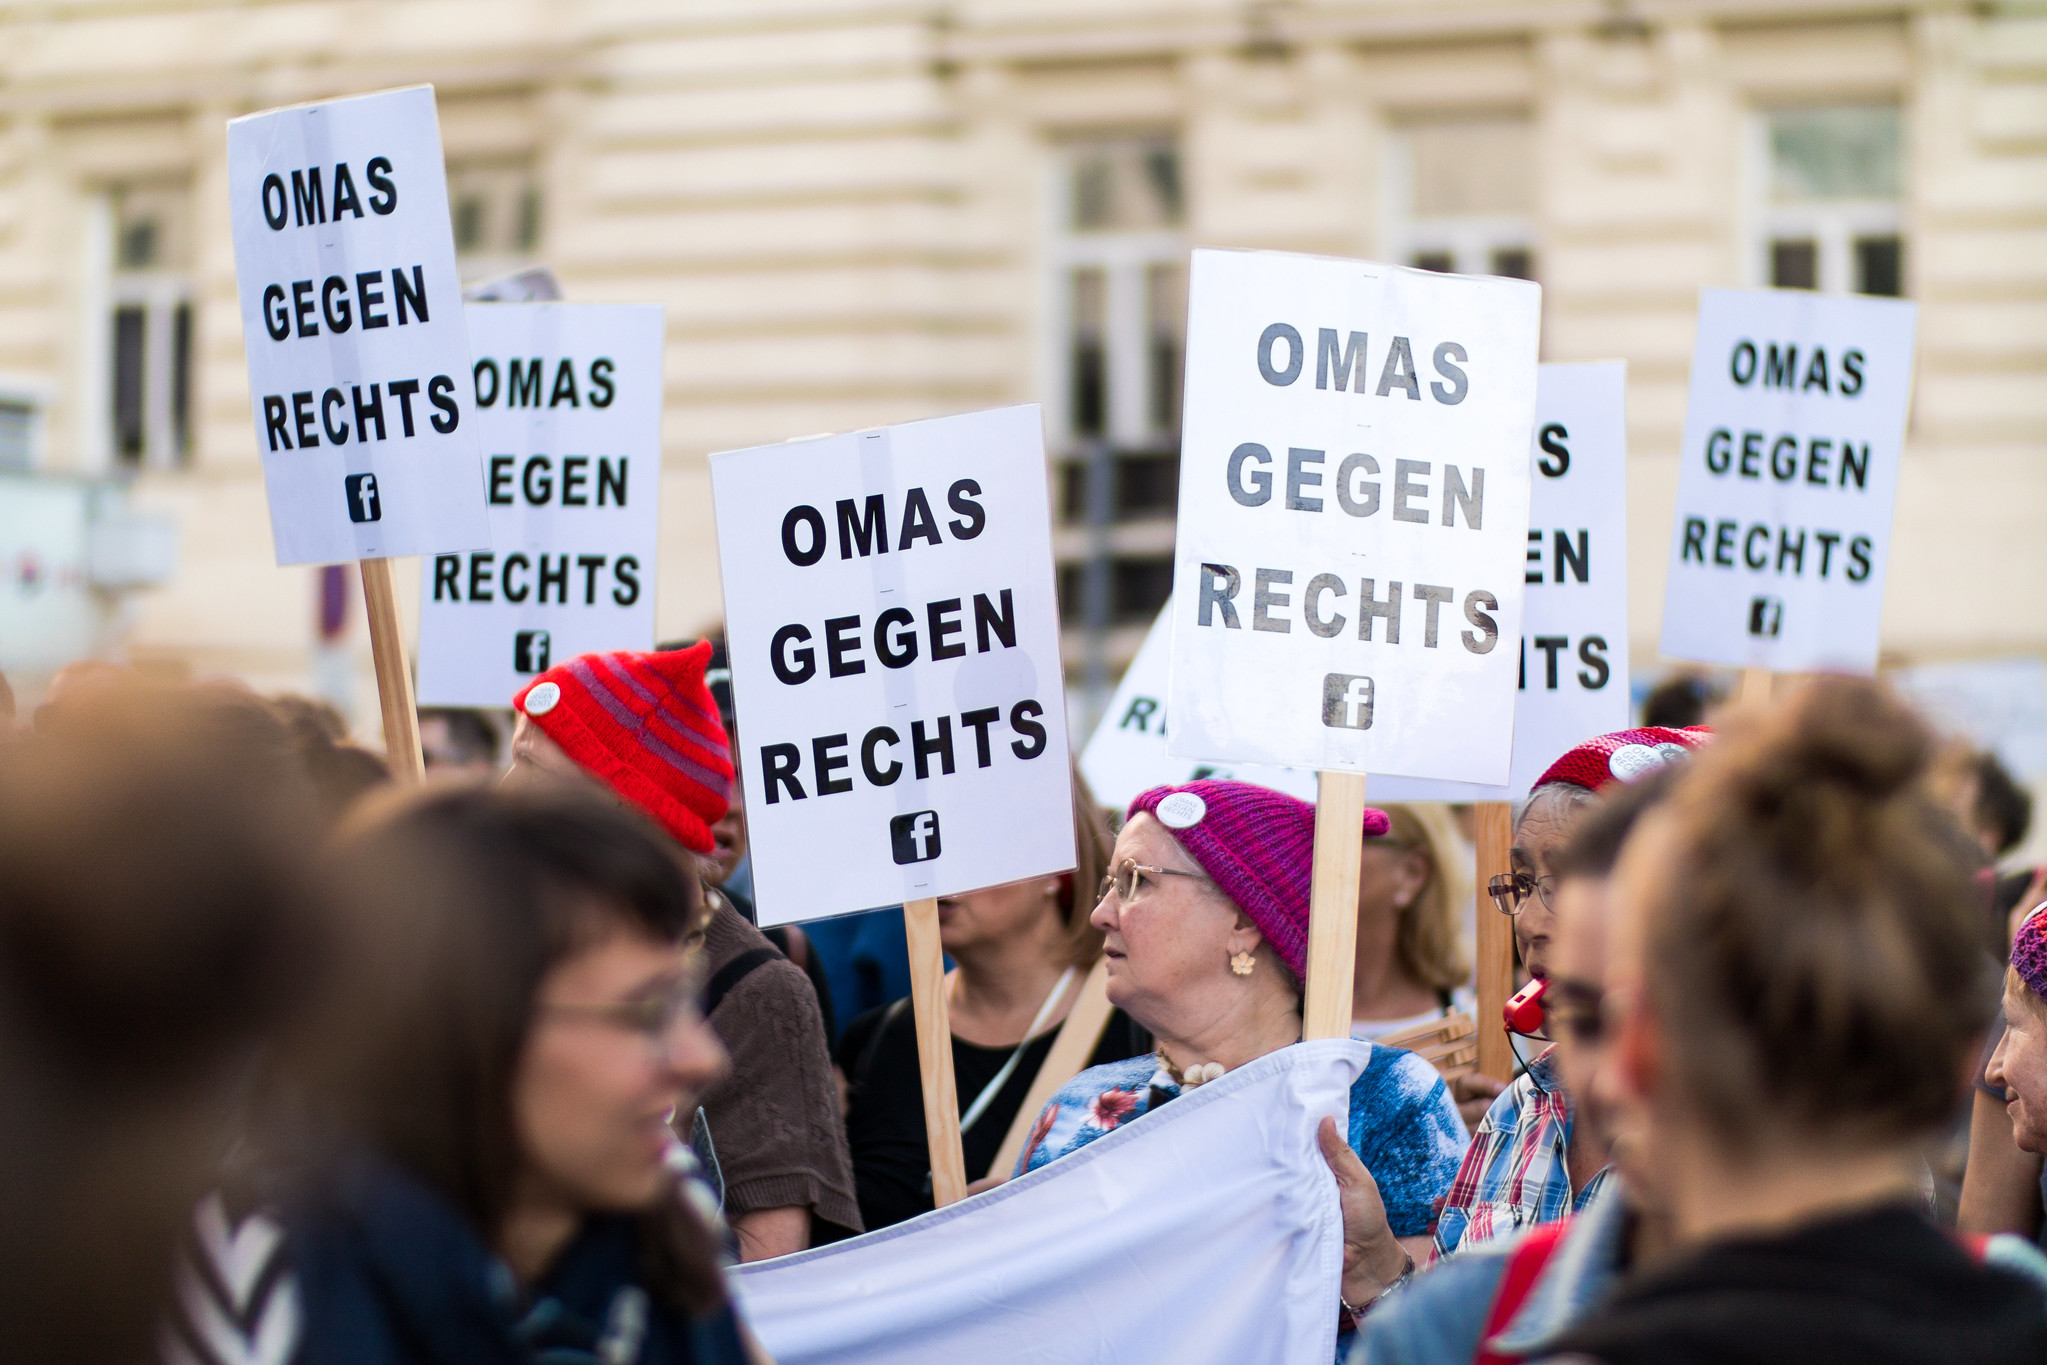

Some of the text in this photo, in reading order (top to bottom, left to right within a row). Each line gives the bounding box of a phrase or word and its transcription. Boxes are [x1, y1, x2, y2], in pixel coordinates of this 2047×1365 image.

[261, 156, 398, 232] OMAS
[262, 264, 430, 342] GEGEN
[473, 357, 616, 409] OMAS
[1256, 322, 1469, 406] OMAS
[1730, 340, 1866, 398] OMAS
[262, 374, 460, 453] RECHTS
[488, 455, 629, 507] EGEN
[1226, 442, 1485, 531] GEGEN
[1704, 428, 1871, 491] GEGEN
[781, 478, 986, 567] OMAS
[1680, 516, 1873, 584] RECHTS
[433, 552, 641, 607] RECHTS
[1197, 562, 1500, 655] RECHTS
[770, 588, 1017, 686] GEGEN
[760, 698, 1047, 806] RECHTS
[1615, 756, 1640, 775] RECH
[1623, 751, 1651, 769] GEGE
